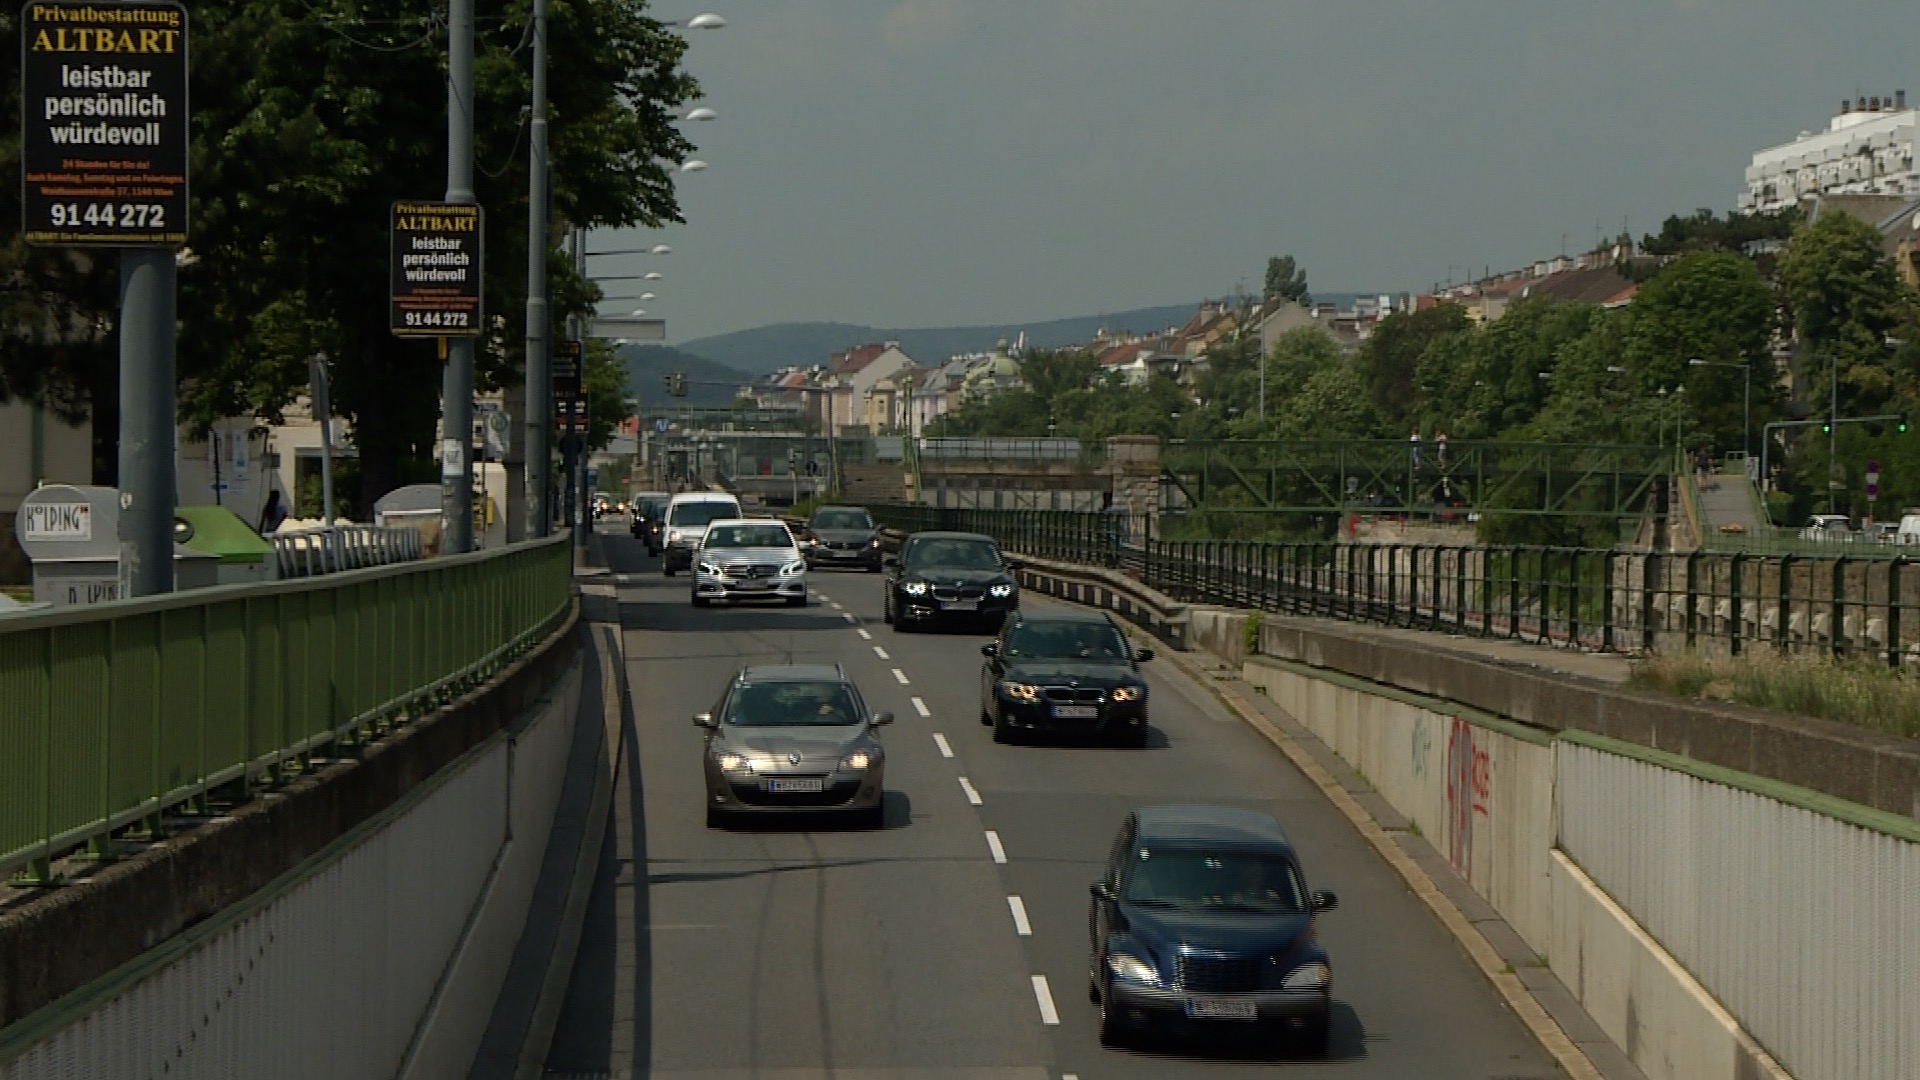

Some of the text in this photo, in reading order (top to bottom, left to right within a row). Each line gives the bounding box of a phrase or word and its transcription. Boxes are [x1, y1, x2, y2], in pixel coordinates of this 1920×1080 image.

[33, 5, 180, 27] Privatbestattung
[32, 27, 180, 53] ALTBART
[61, 64, 152, 88] leistbar
[45, 92, 167, 120] persönlich
[50, 121, 160, 145] würdevoll
[396, 216, 477, 231] ALTBART
[412, 236, 462, 250] leistbar
[403, 251, 470, 268] persönlich
[405, 267, 466, 281] würdevoll
